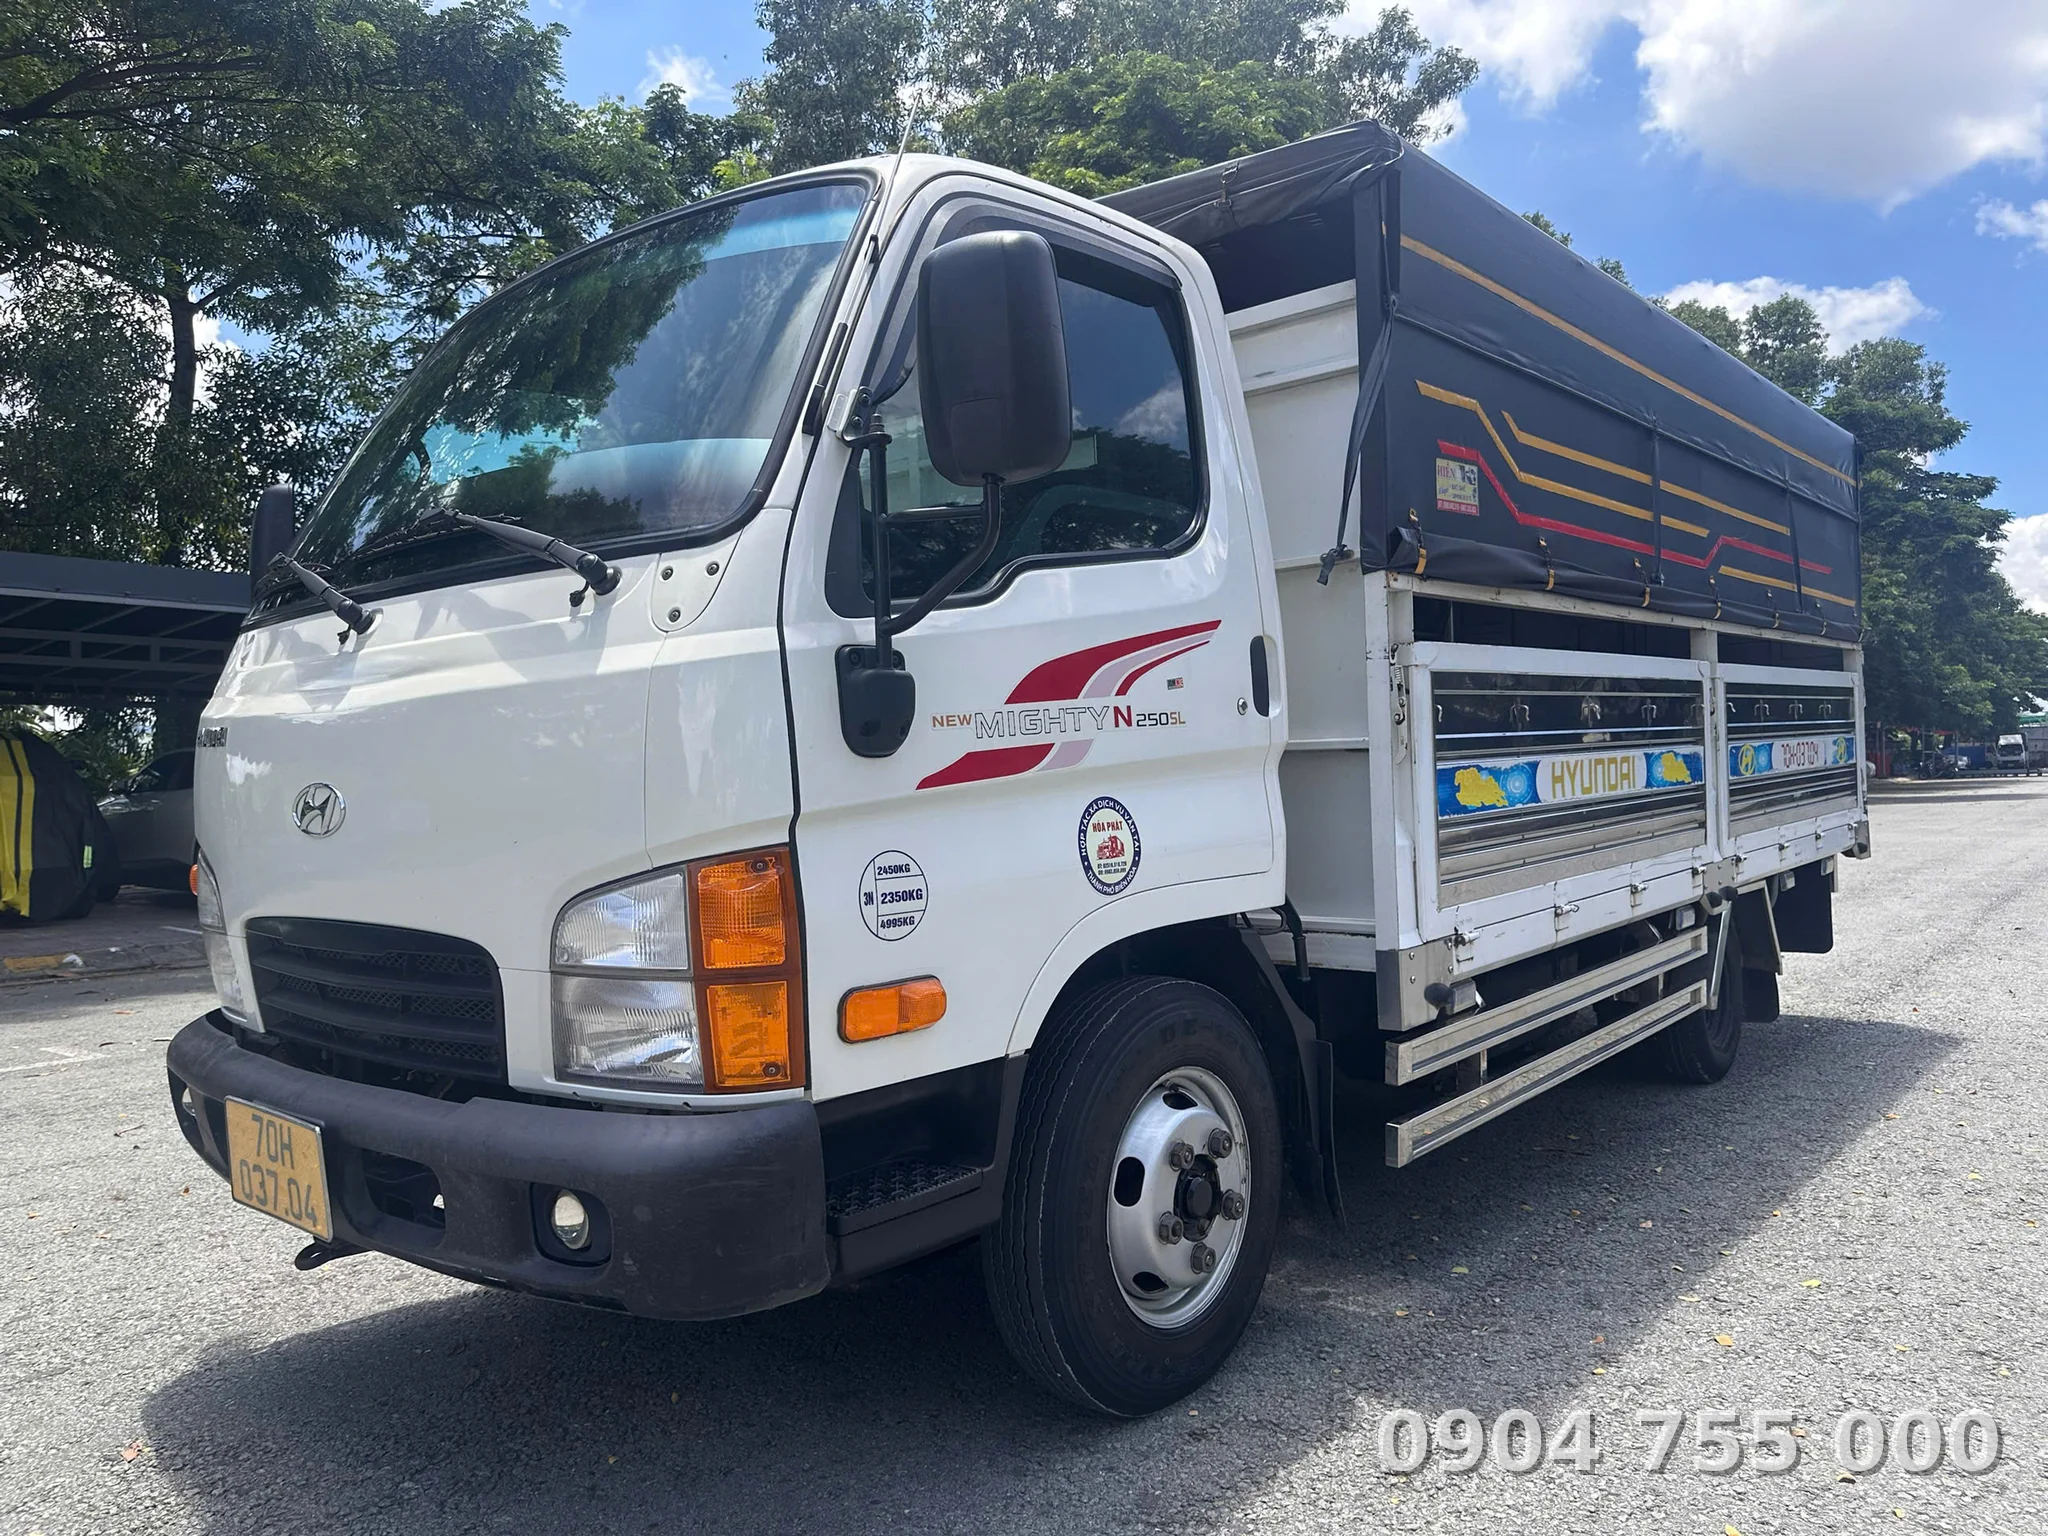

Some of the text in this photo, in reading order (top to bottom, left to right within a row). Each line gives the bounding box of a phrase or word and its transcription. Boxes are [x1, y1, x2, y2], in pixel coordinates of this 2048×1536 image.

[932, 705, 1186, 739] NEW MIGHTY N 250SL
[1550, 754, 1637, 799] HYUNDAI
[1107, 819, 1123, 832] PHÁT
[877, 863, 911, 876] 2450KG
[863, 892, 874, 906] 3N
[880, 888, 923, 905] 2350KG
[880, 916, 915, 930] 4995KG
[252, 1113, 294, 1170] 70H
